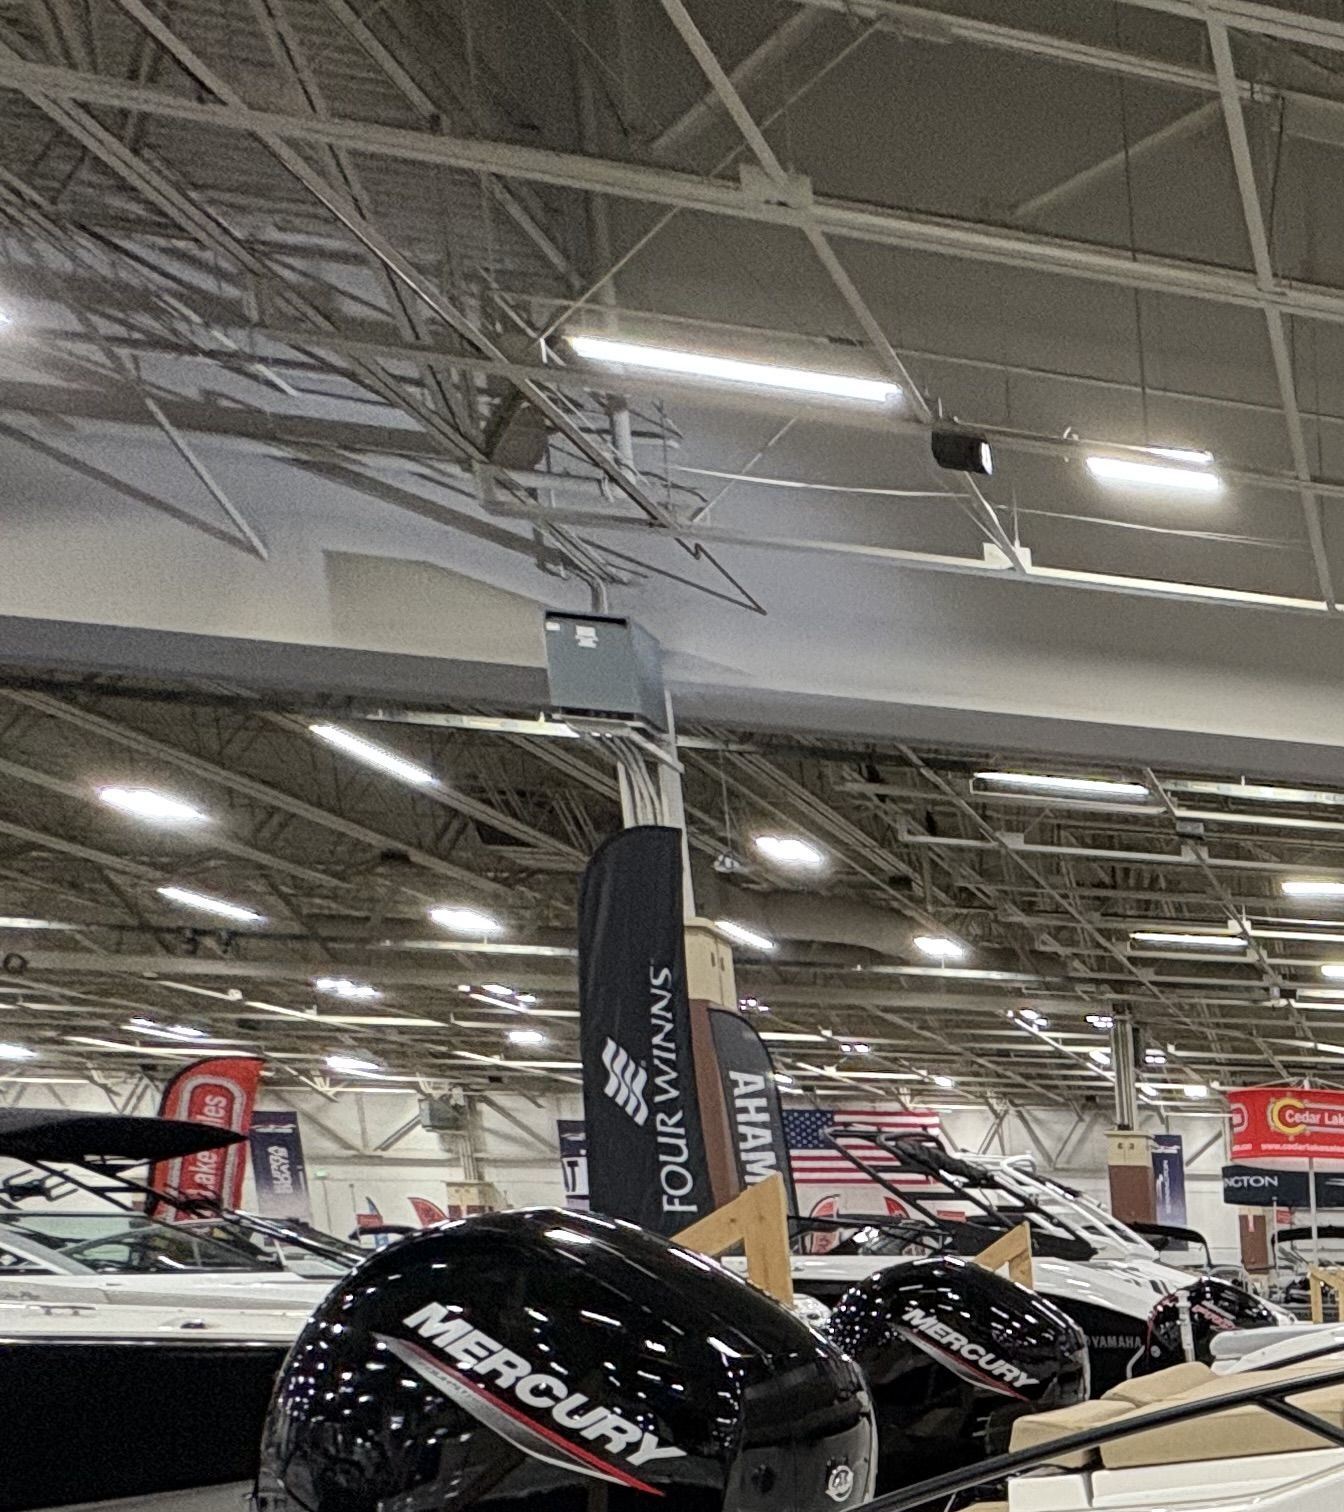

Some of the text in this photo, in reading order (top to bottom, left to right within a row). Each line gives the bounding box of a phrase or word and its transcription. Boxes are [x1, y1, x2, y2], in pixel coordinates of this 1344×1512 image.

[650, 966, 698, 1214] FOUR WINNS
[1285, 1109, 1321, 1125] Cedar
[902, 1308, 1040, 1388] MERCURY
[1091, 1335, 1143, 1349] YAMAHA
[402, 1301, 688, 1466] MERCURY
